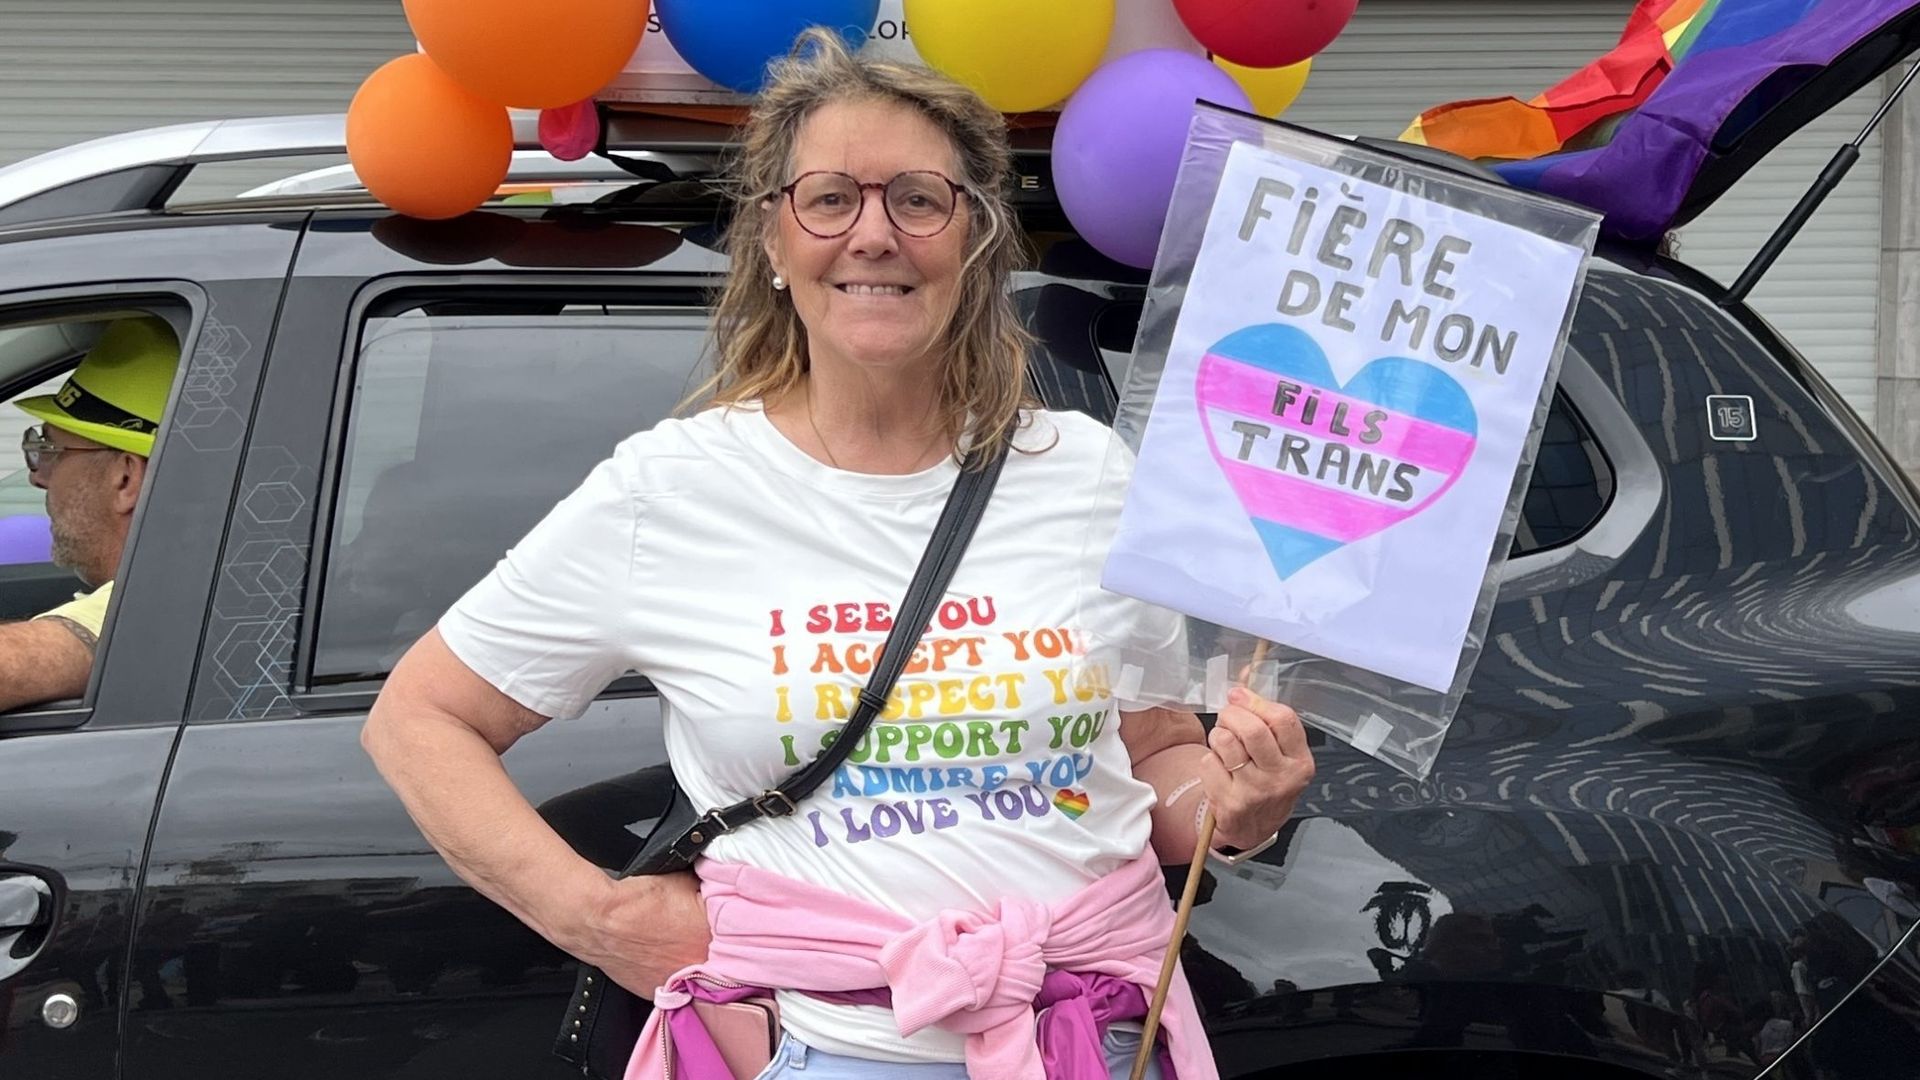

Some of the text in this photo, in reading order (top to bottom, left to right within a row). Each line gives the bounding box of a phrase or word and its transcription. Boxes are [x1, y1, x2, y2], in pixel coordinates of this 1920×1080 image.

[1276, 269, 1519, 375] DE MON
[1717, 406, 1745, 429] 15
[1231, 420, 1420, 502] TRANS
[769, 595, 996, 637] I SEE OU
[772, 645, 789, 675] I
[775, 686, 793, 723] I
[780, 734, 800, 767] I
[1047, 709, 1109, 749] YOU
[831, 752, 1094, 799] ADMIRE YOU
[807, 784, 1051, 848] I LOVE YOU
